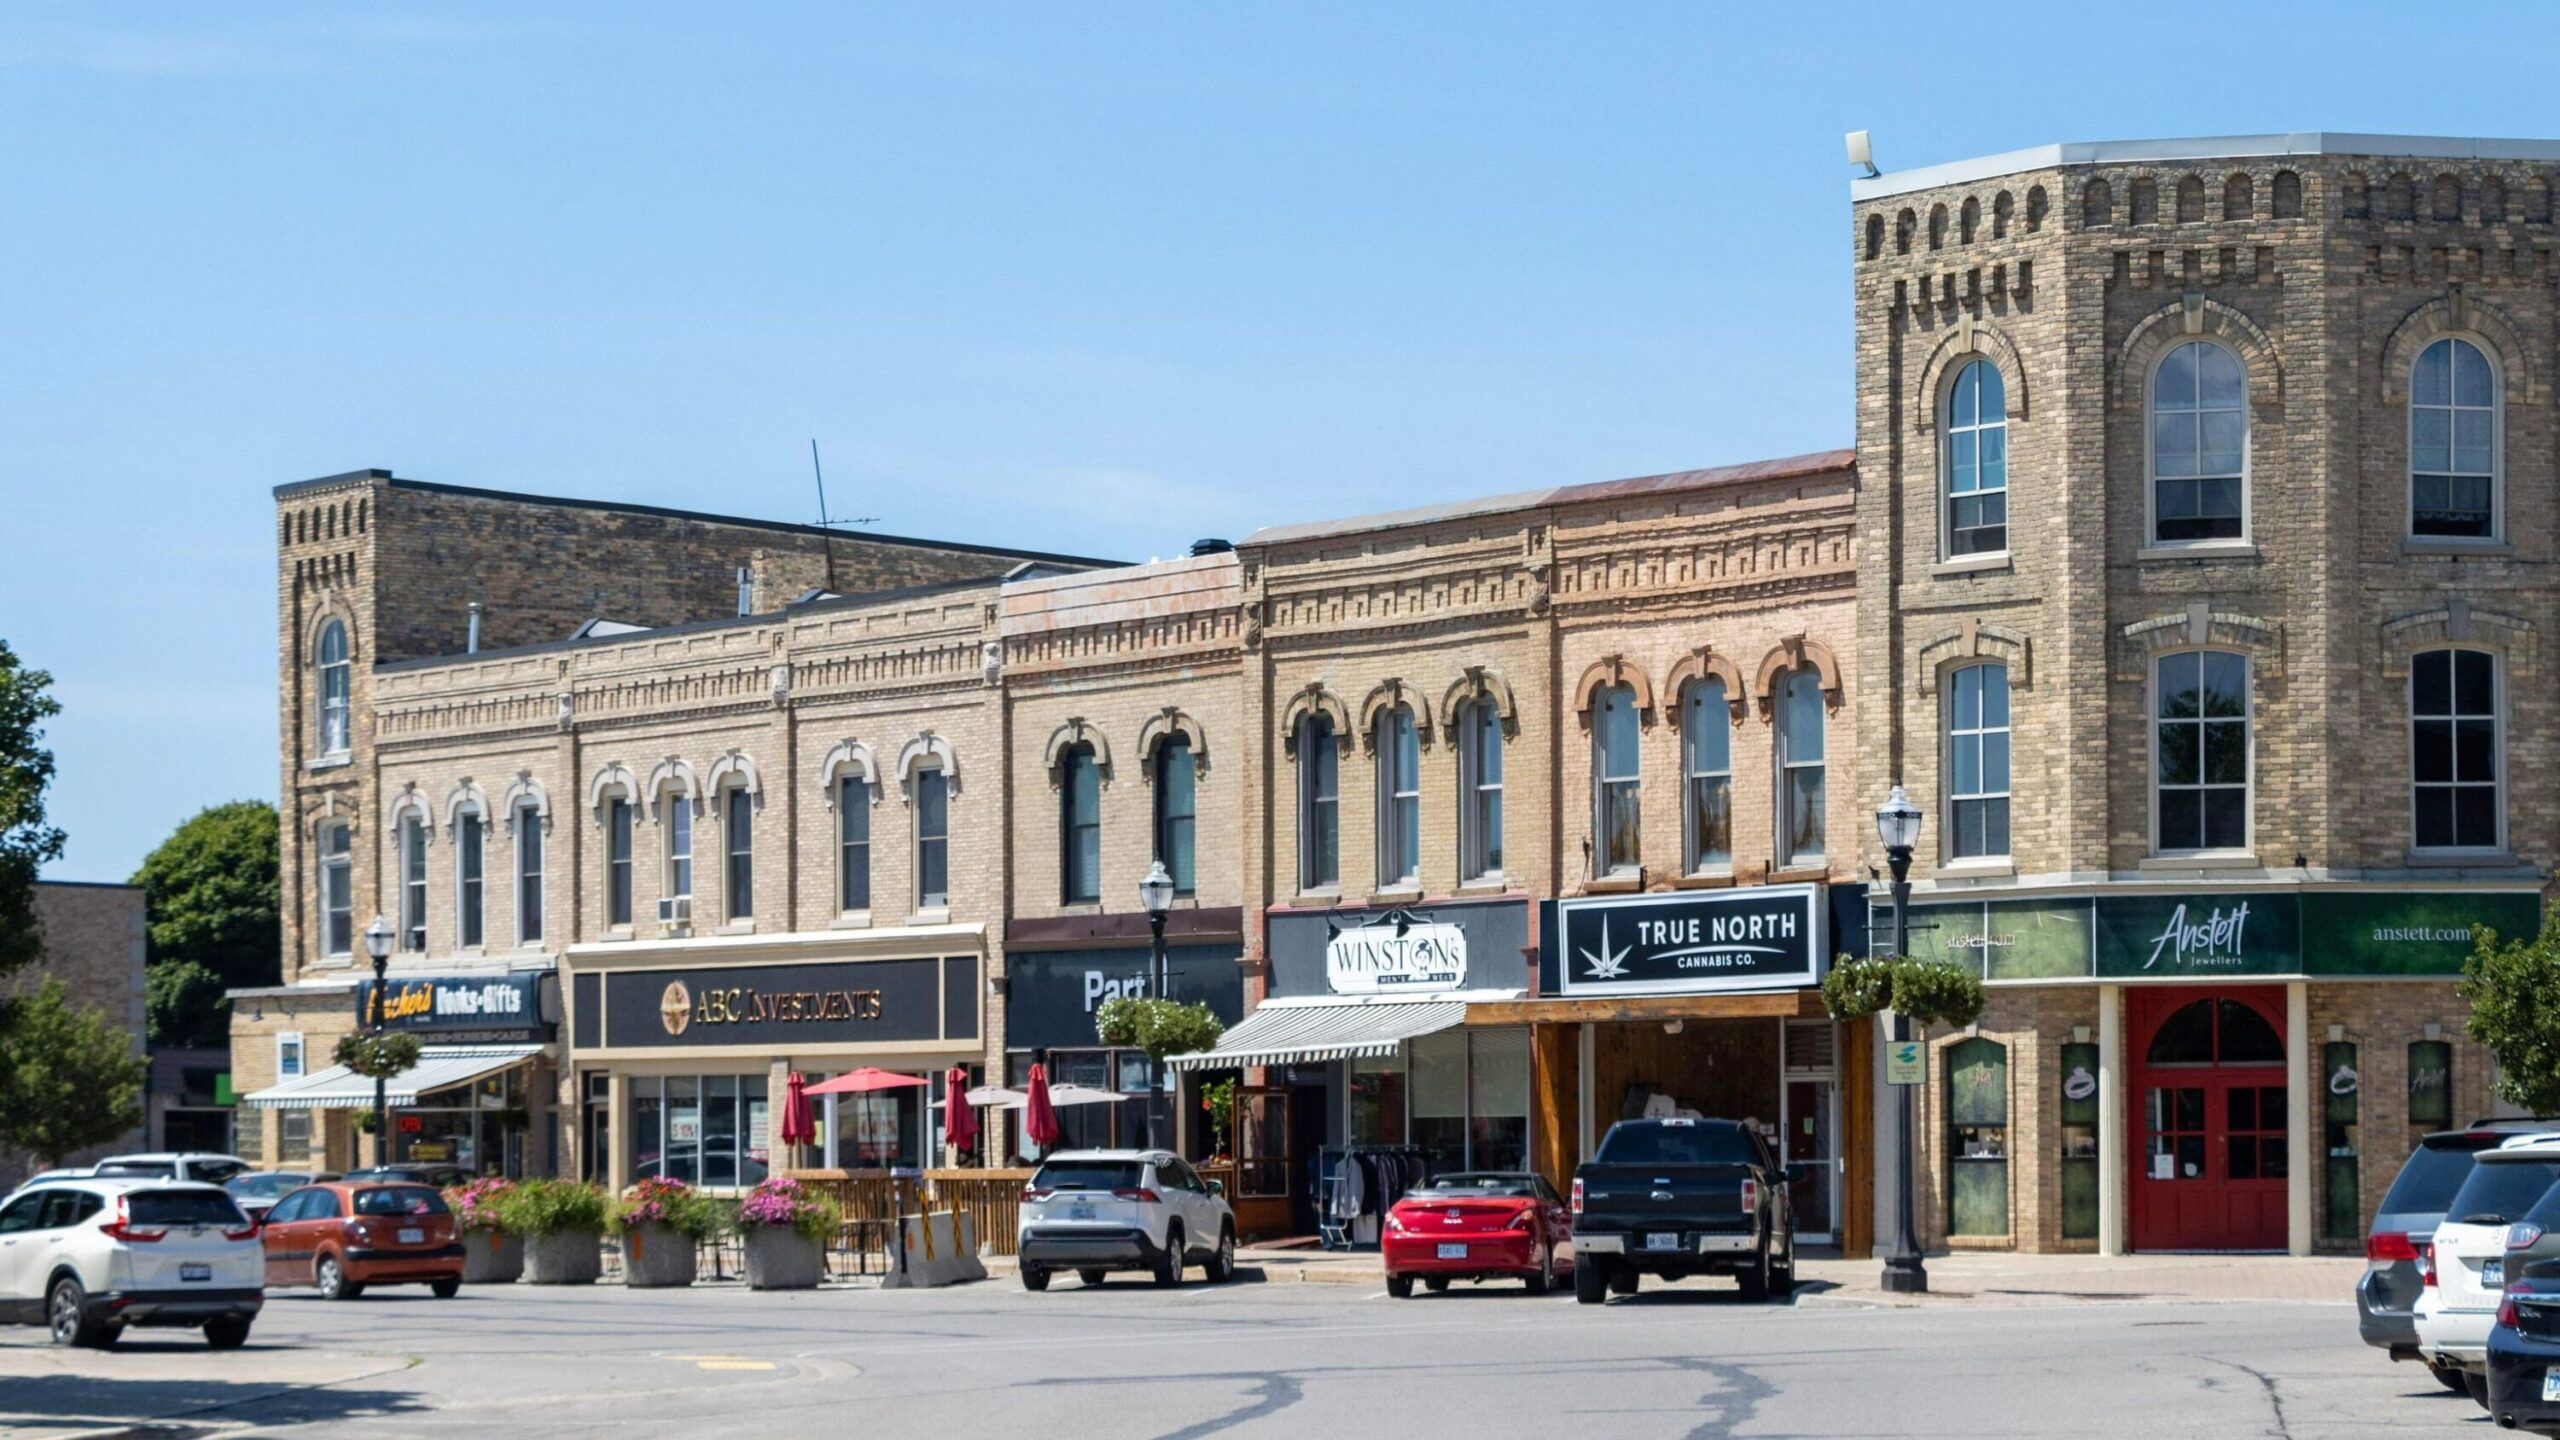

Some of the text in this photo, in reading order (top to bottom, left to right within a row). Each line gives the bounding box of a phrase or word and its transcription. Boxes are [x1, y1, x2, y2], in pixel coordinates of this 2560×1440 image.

[1638, 913, 1796, 945] TRUE NORTH
[2143, 901, 2251, 969] Anstett
[2373, 927, 2471, 941] anstett.com
[1677, 954, 1755, 968] CANNABIS CO.
[2191, 956, 2242, 967] Jewellers
[1381, 973, 1456, 983] MEN'S WEAR
[696, 988, 741, 1023] ABC
